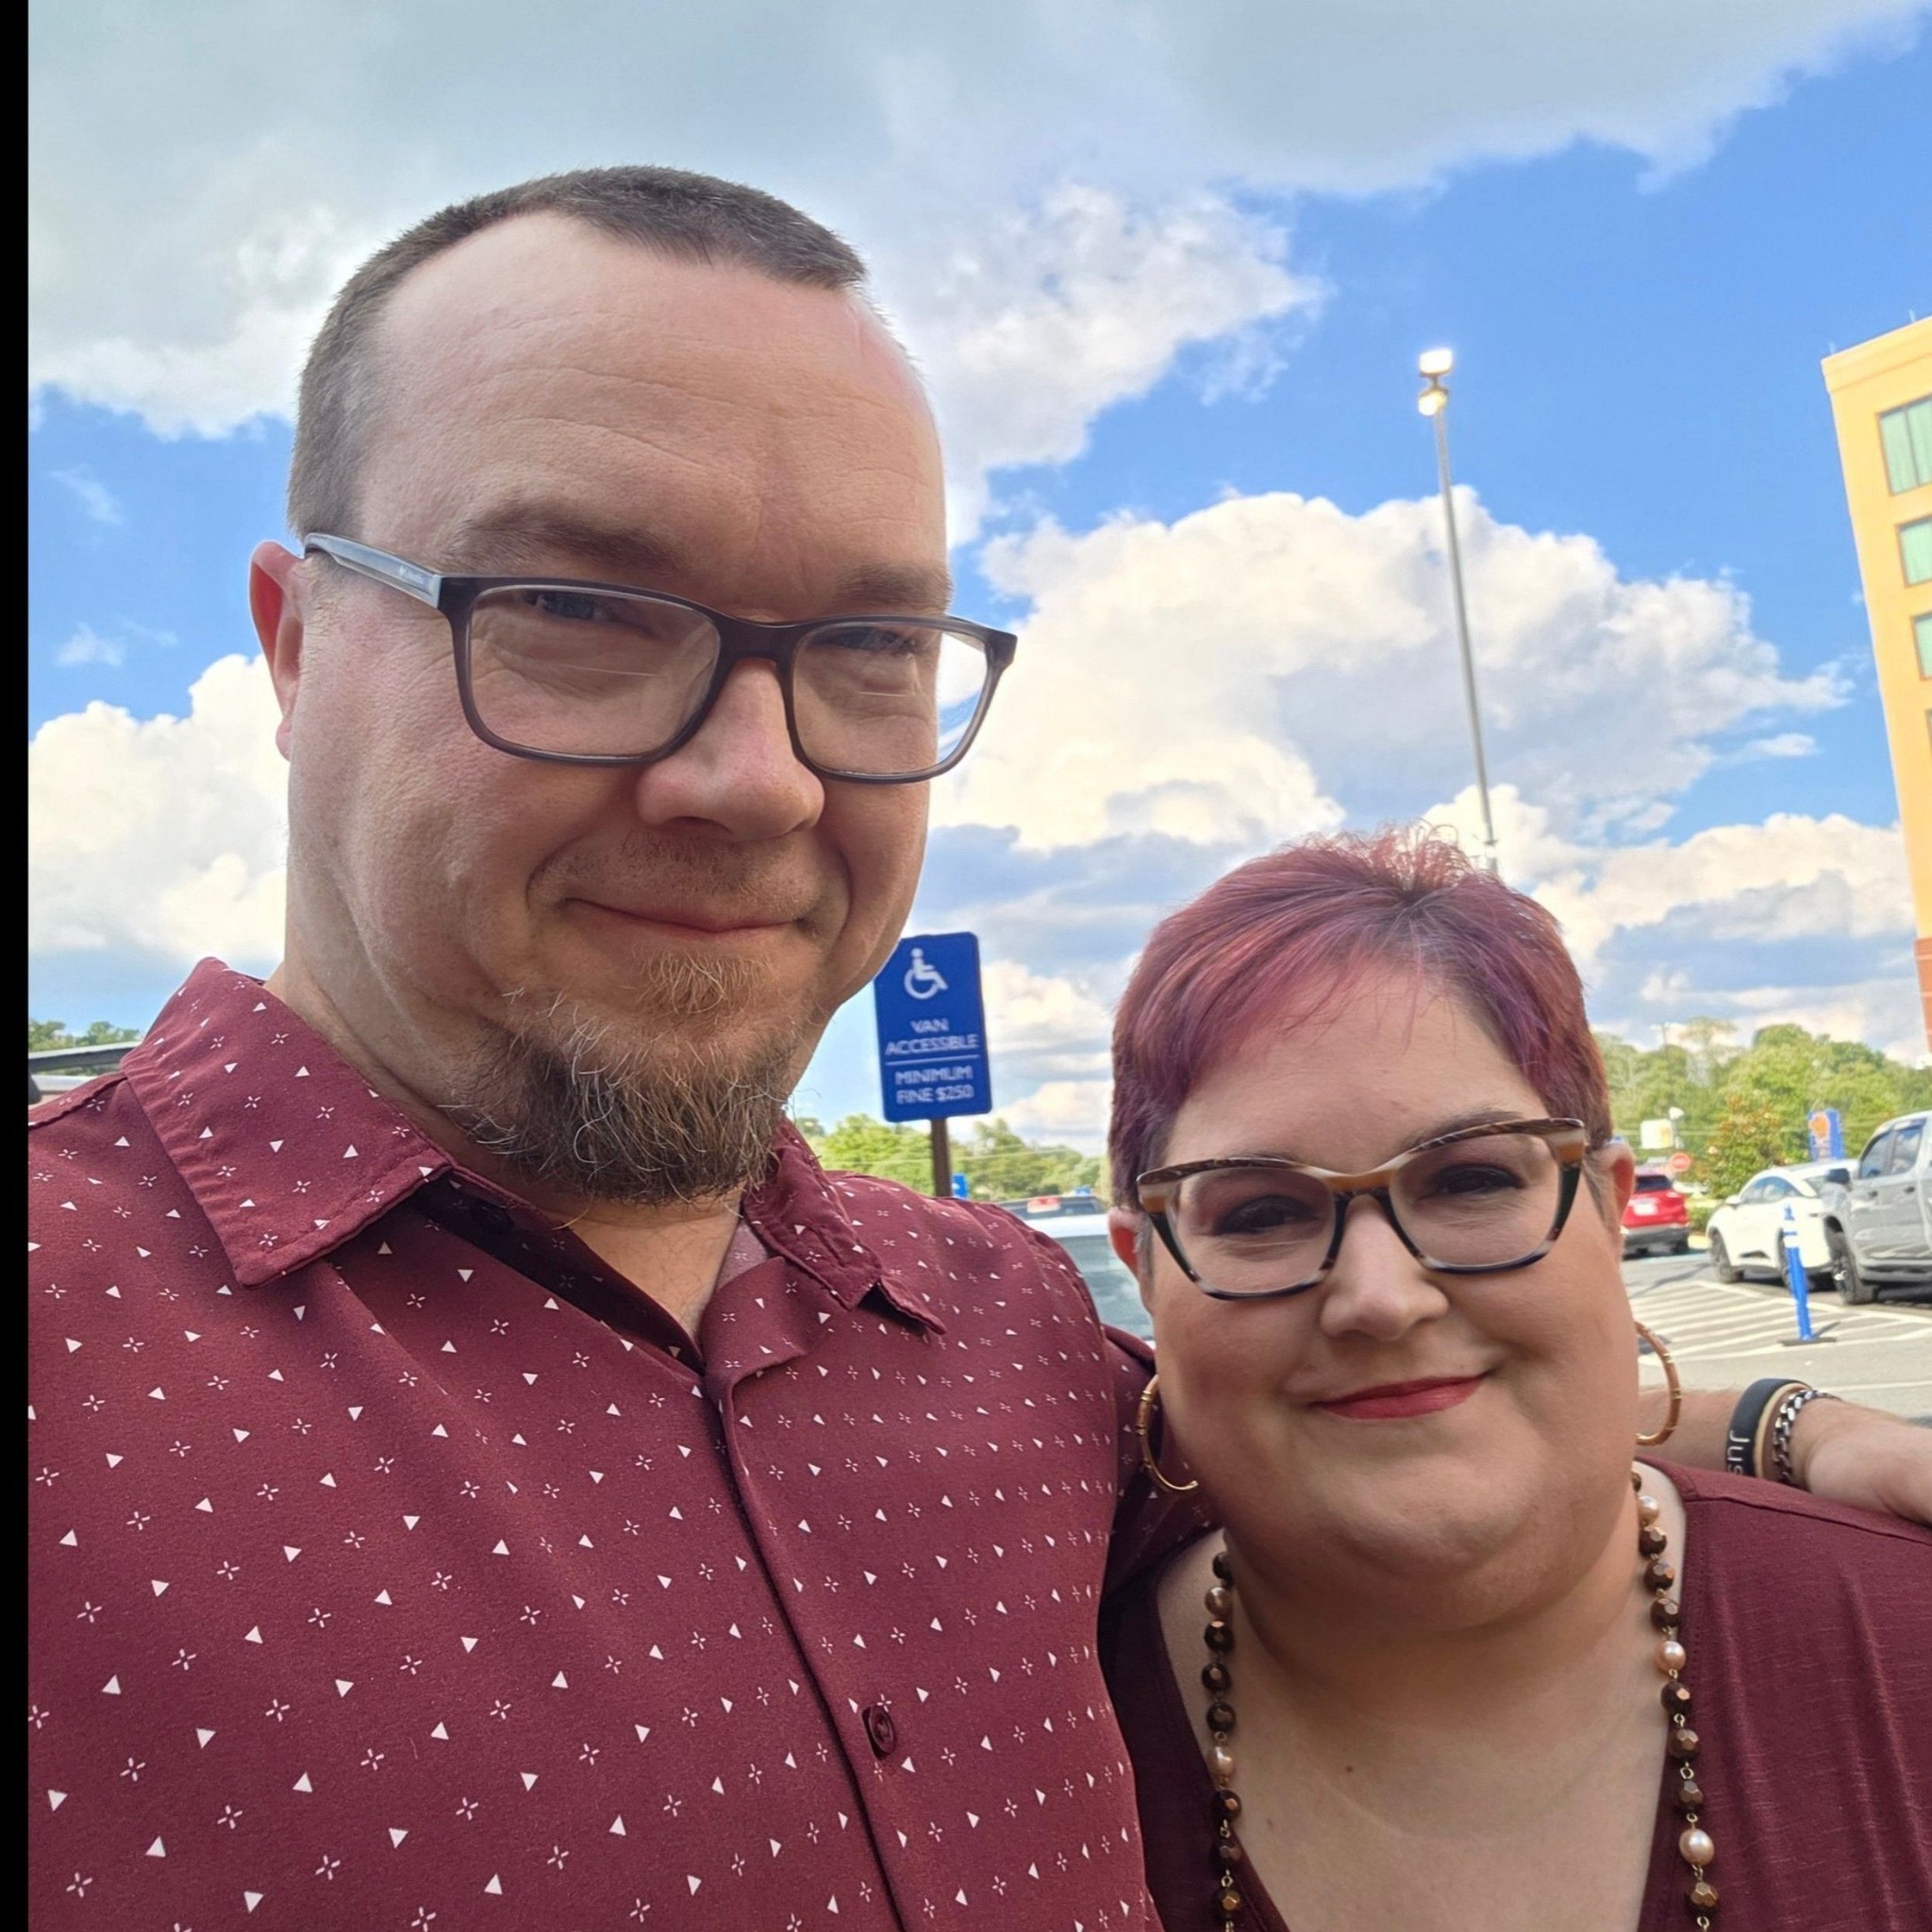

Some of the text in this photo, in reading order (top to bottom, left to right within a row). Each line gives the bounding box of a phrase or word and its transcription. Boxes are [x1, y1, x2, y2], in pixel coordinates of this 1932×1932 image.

[909, 1018, 949, 1033] VAN
[885, 1034, 979, 1056] ACCESSIBLE
[894, 1065, 973, 1085] MINIMUM
[896, 1084, 974, 1105] FINE $250
